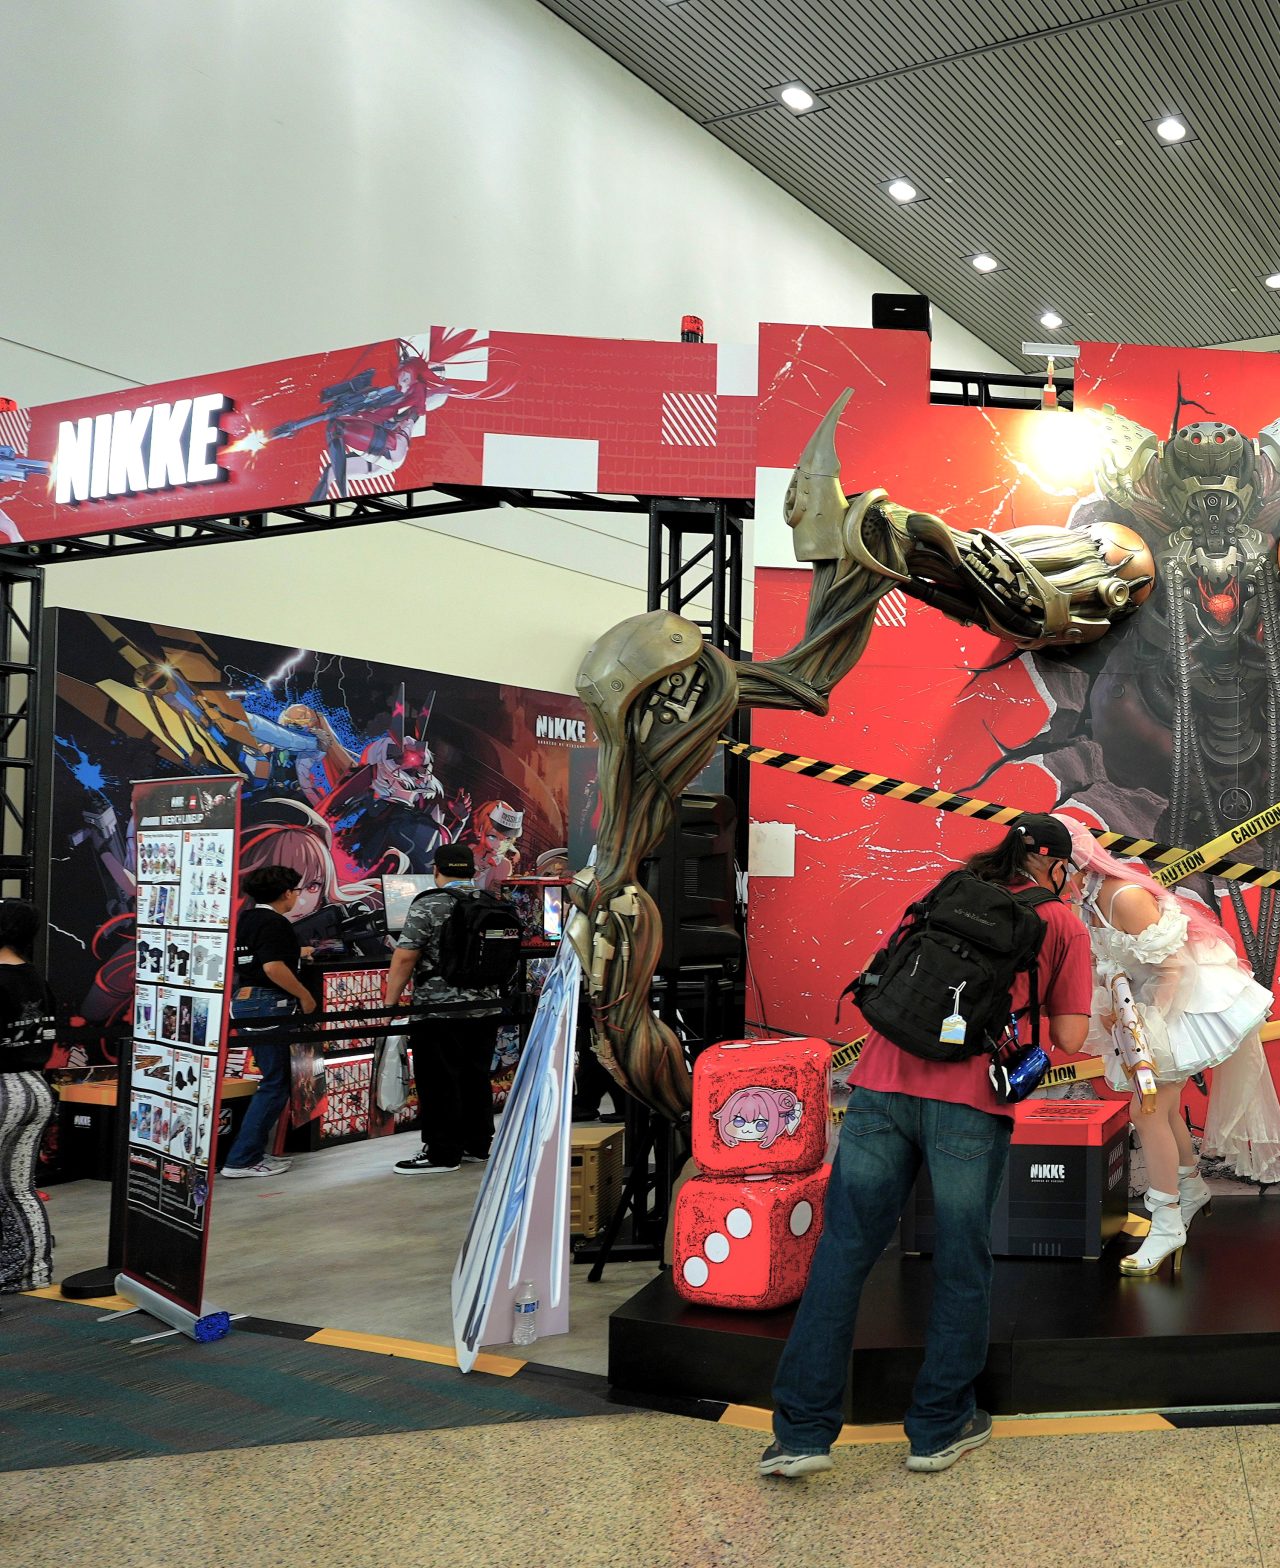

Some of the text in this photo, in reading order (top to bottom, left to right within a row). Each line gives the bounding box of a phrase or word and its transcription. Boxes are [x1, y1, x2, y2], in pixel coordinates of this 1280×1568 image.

[55, 393, 223, 503] NIKKE
[536, 715, 586, 742] NIKKE
[1030, 1164, 1065, 1179] NIKKE
